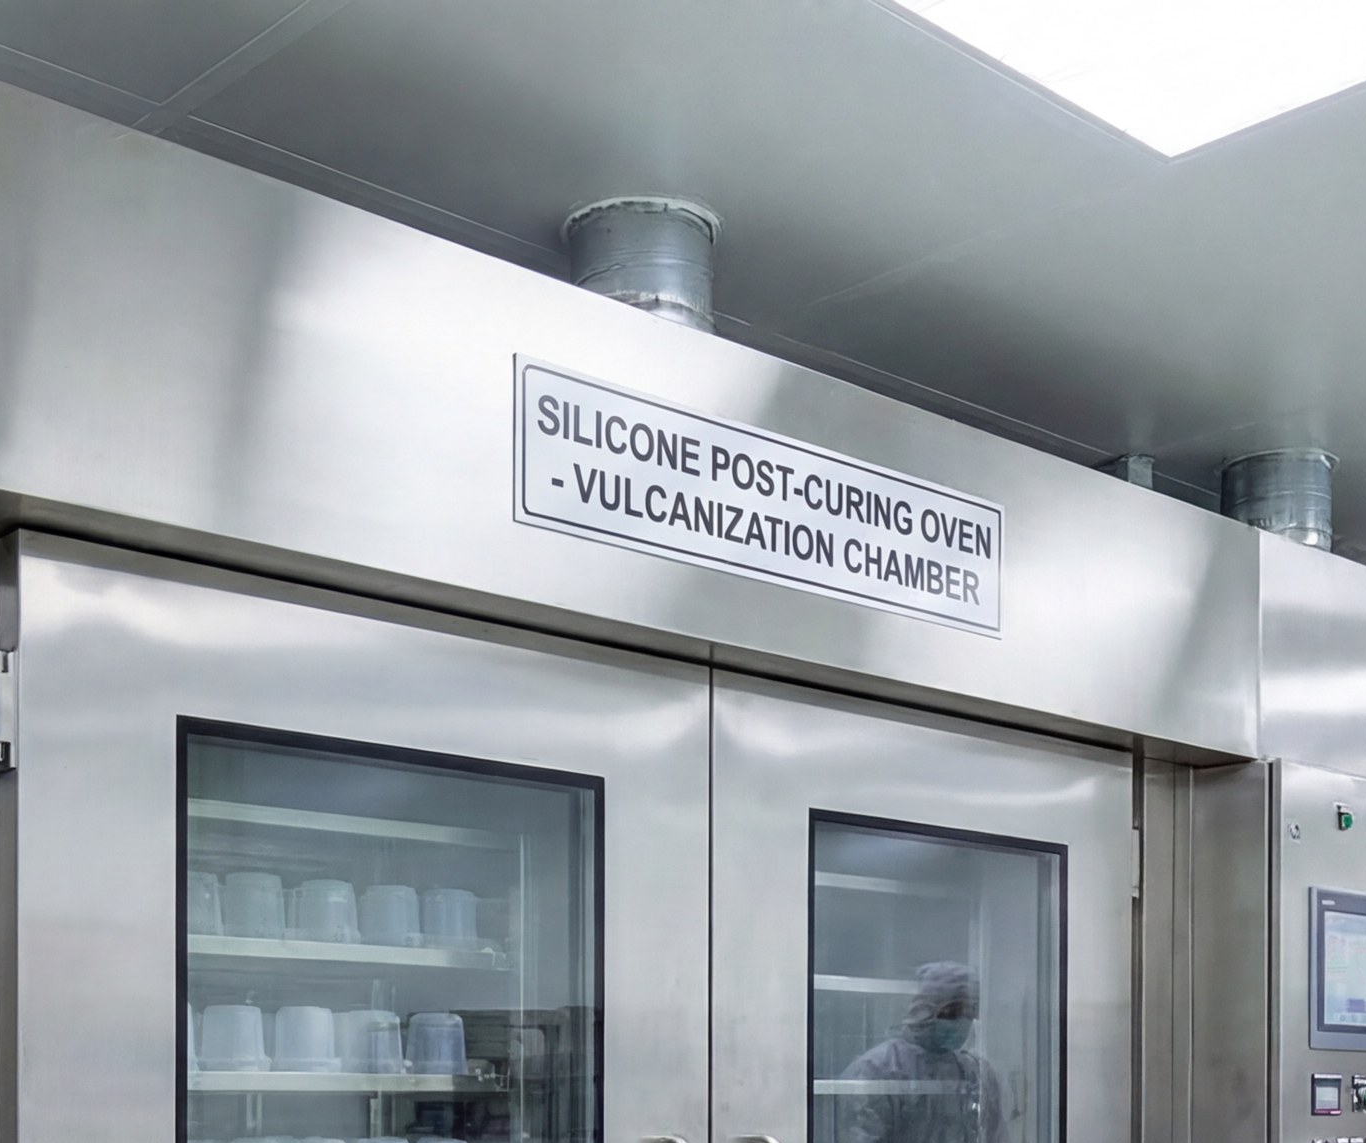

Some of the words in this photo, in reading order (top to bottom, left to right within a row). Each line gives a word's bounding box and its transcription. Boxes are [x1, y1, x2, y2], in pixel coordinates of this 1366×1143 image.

[536, 394, 701, 478] SILICONE
[710, 444, 914, 536] POST-CURING
[920, 508, 992, 560] OVEN
[572, 462, 835, 569] VULCANIZATION
[843, 537, 980, 606] CHAMBER
